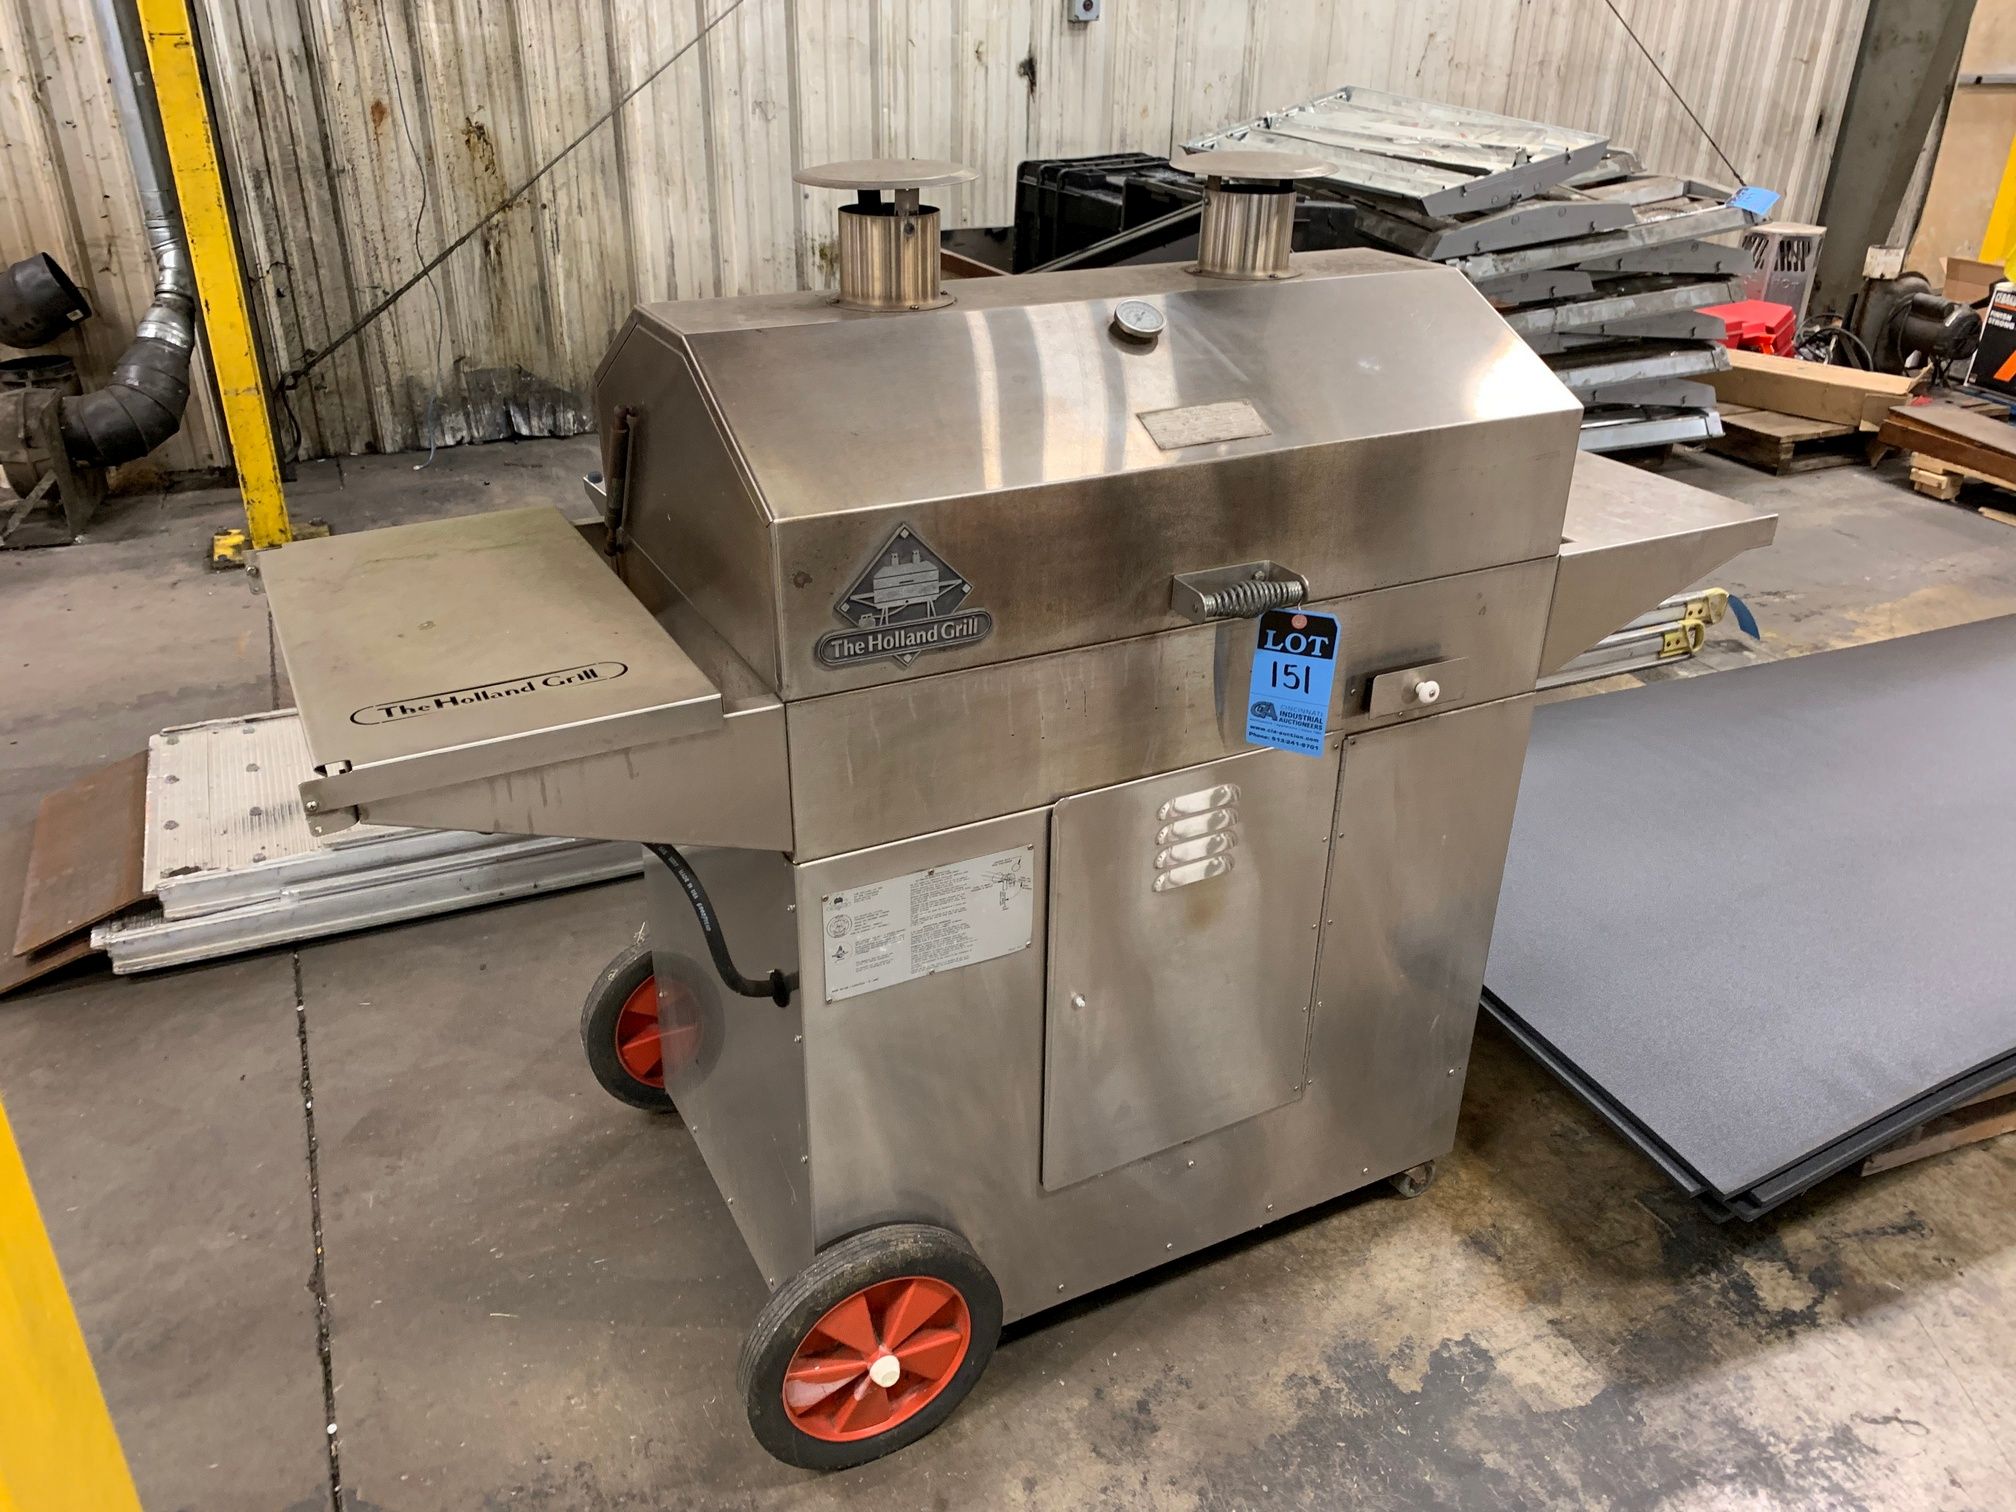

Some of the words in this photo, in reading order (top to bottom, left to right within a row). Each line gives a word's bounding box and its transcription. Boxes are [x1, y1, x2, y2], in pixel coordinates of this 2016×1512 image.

[1988, 317, 2015, 330] STRONG
[831, 638, 865, 657] The
[868, 625, 938, 652] Holland
[941, 616, 978, 640] Grill
[1264, 629, 1329, 656] LOT
[1271, 660, 1311, 695] 151
[377, 704, 430, 718] The
[433, 681, 536, 709] Holland
[542, 668, 599, 687] Grill
[1279, 703, 1324, 717] CINCINNATI
[1279, 710, 1323, 725] INDUSTRIAL
[1278, 718, 1323, 731] AUCTIONEERS
[1248, 731, 1270, 742] Phone:
[678, 869, 690, 883] MADE
[690, 888, 699, 900] USA
